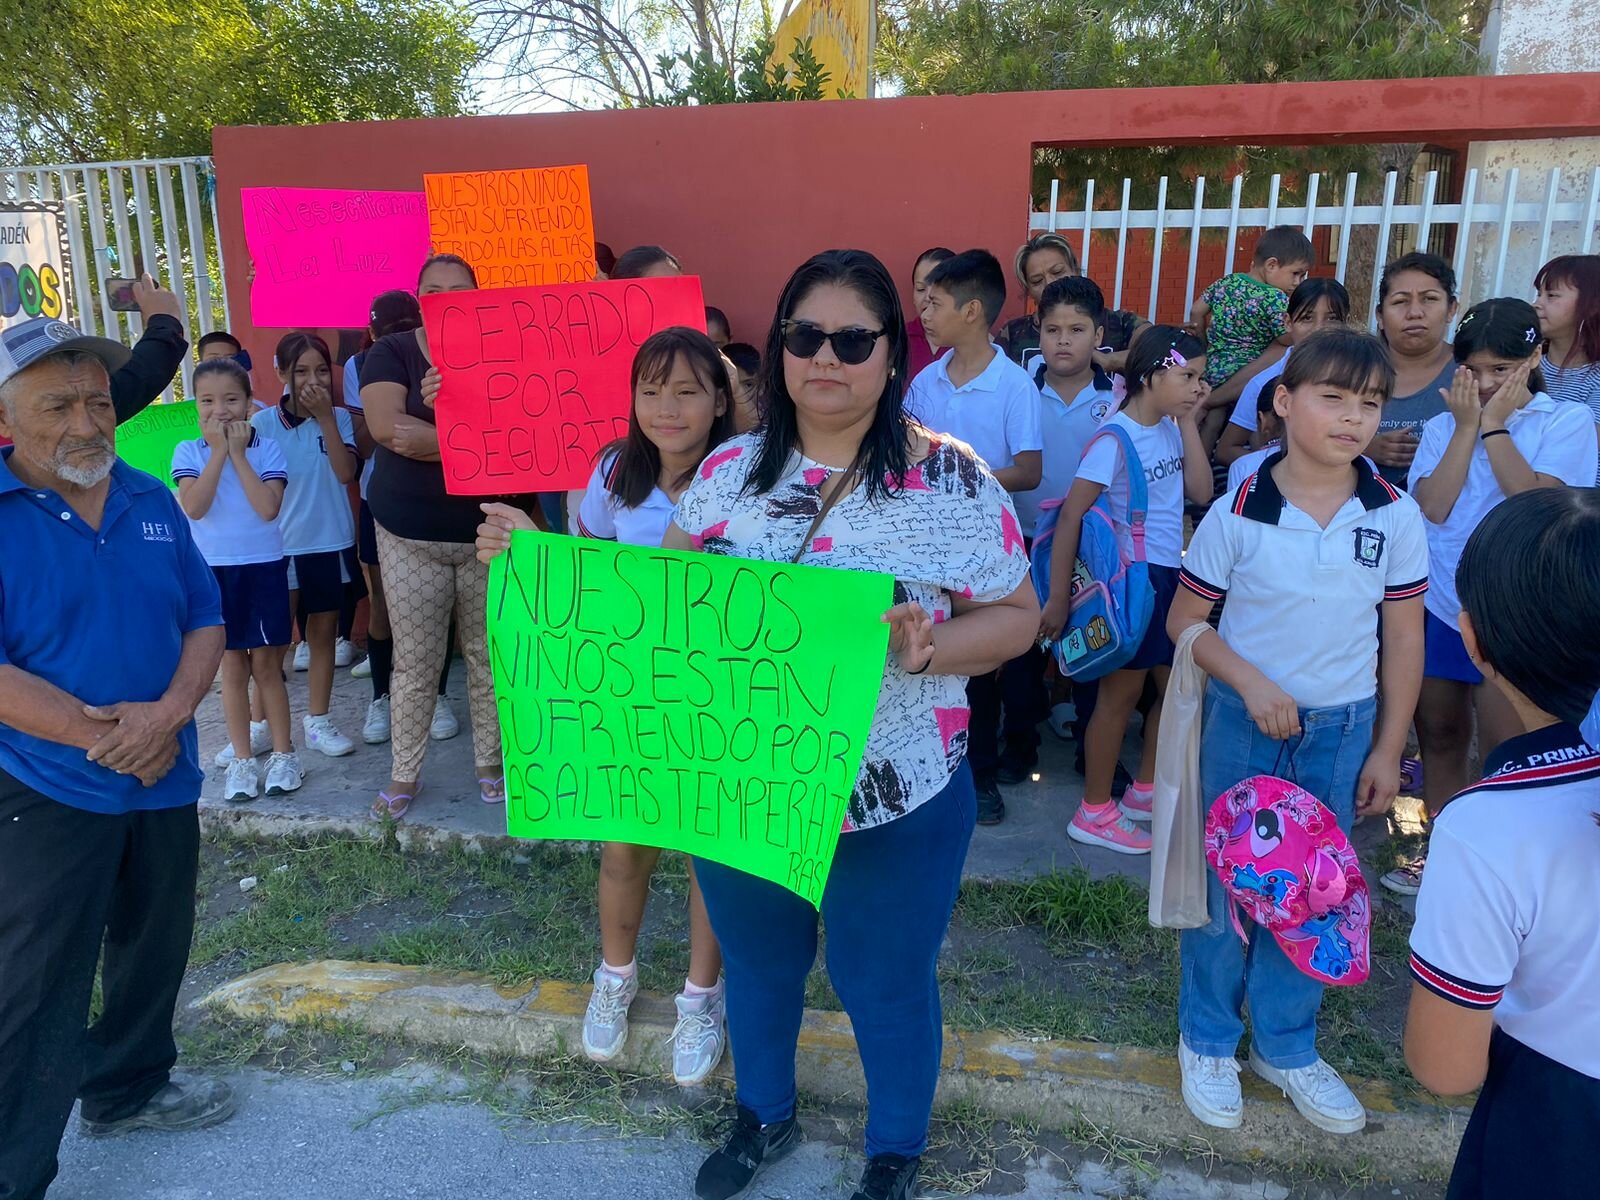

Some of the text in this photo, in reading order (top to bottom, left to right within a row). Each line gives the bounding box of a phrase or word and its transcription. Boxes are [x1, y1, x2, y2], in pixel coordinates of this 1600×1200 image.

[426, 168, 581, 208] NUESTROS NIÑOS
[430, 205, 585, 236] ESTAN SUFRIENDO
[497, 237, 507, 258] A
[510, 237, 538, 259] LAS
[541, 233, 593, 259] ALTAS
[264, 236, 393, 284] La Luz
[441, 284, 654, 369] CERRADO
[486, 369, 592, 424] POR
[142, 521, 170, 536] HFI
[497, 543, 803, 654] NUESTROS
[491, 630, 837, 717] NIÑOS ESTAN
[771, 724, 851, 788] POR
[508, 762, 551, 823] AS
[556, 762, 662, 826] ALTAS
[786, 851, 825, 903] RAS
